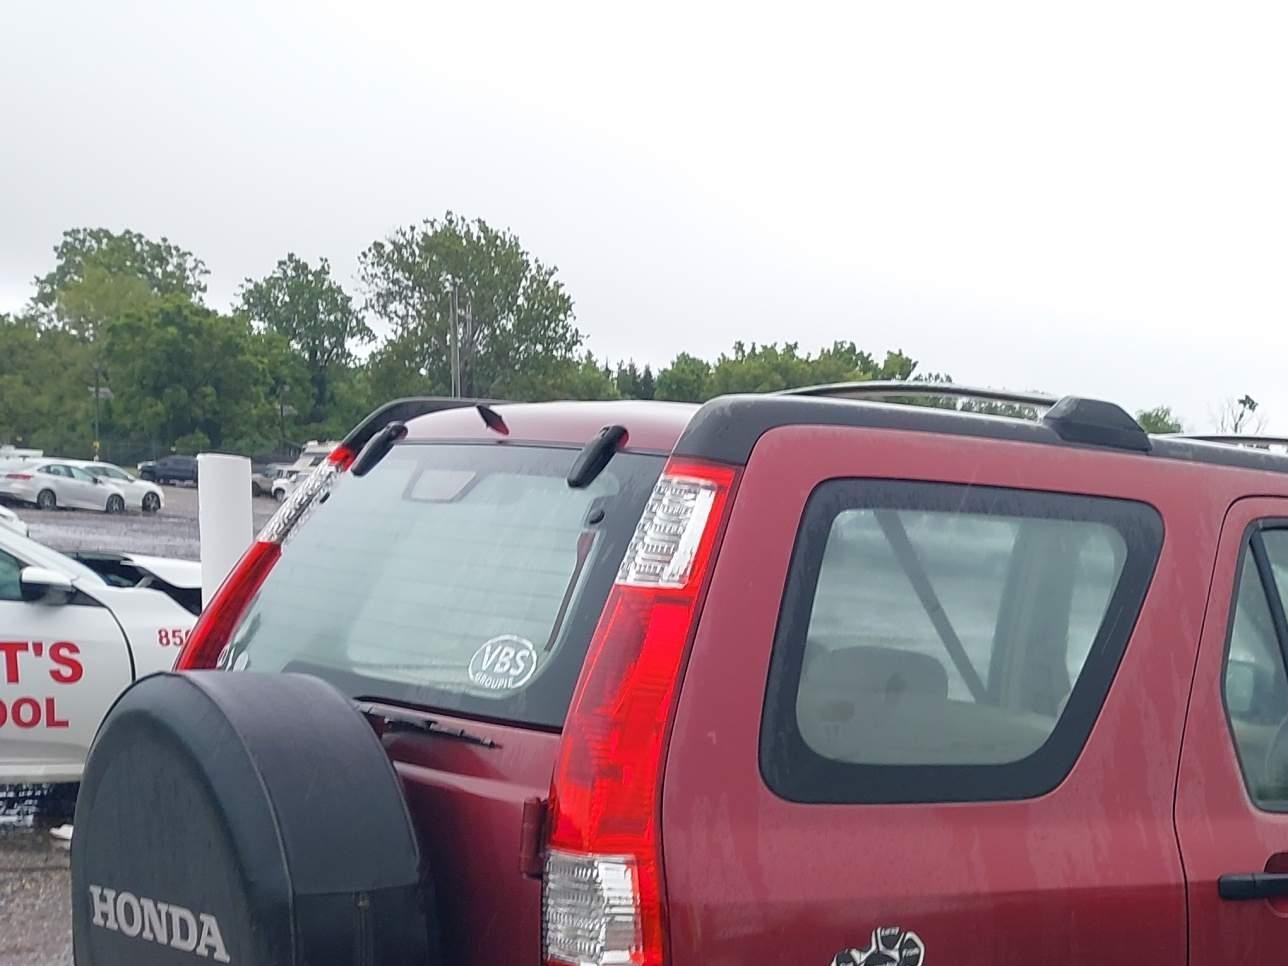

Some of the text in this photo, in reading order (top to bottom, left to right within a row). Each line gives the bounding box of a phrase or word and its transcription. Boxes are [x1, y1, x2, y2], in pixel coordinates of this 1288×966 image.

[0, 641, 83, 684] T'S
[481, 645, 530, 676] VBS
[0, 697, 69, 728] OL
[89, 884, 231, 963] HONDA
